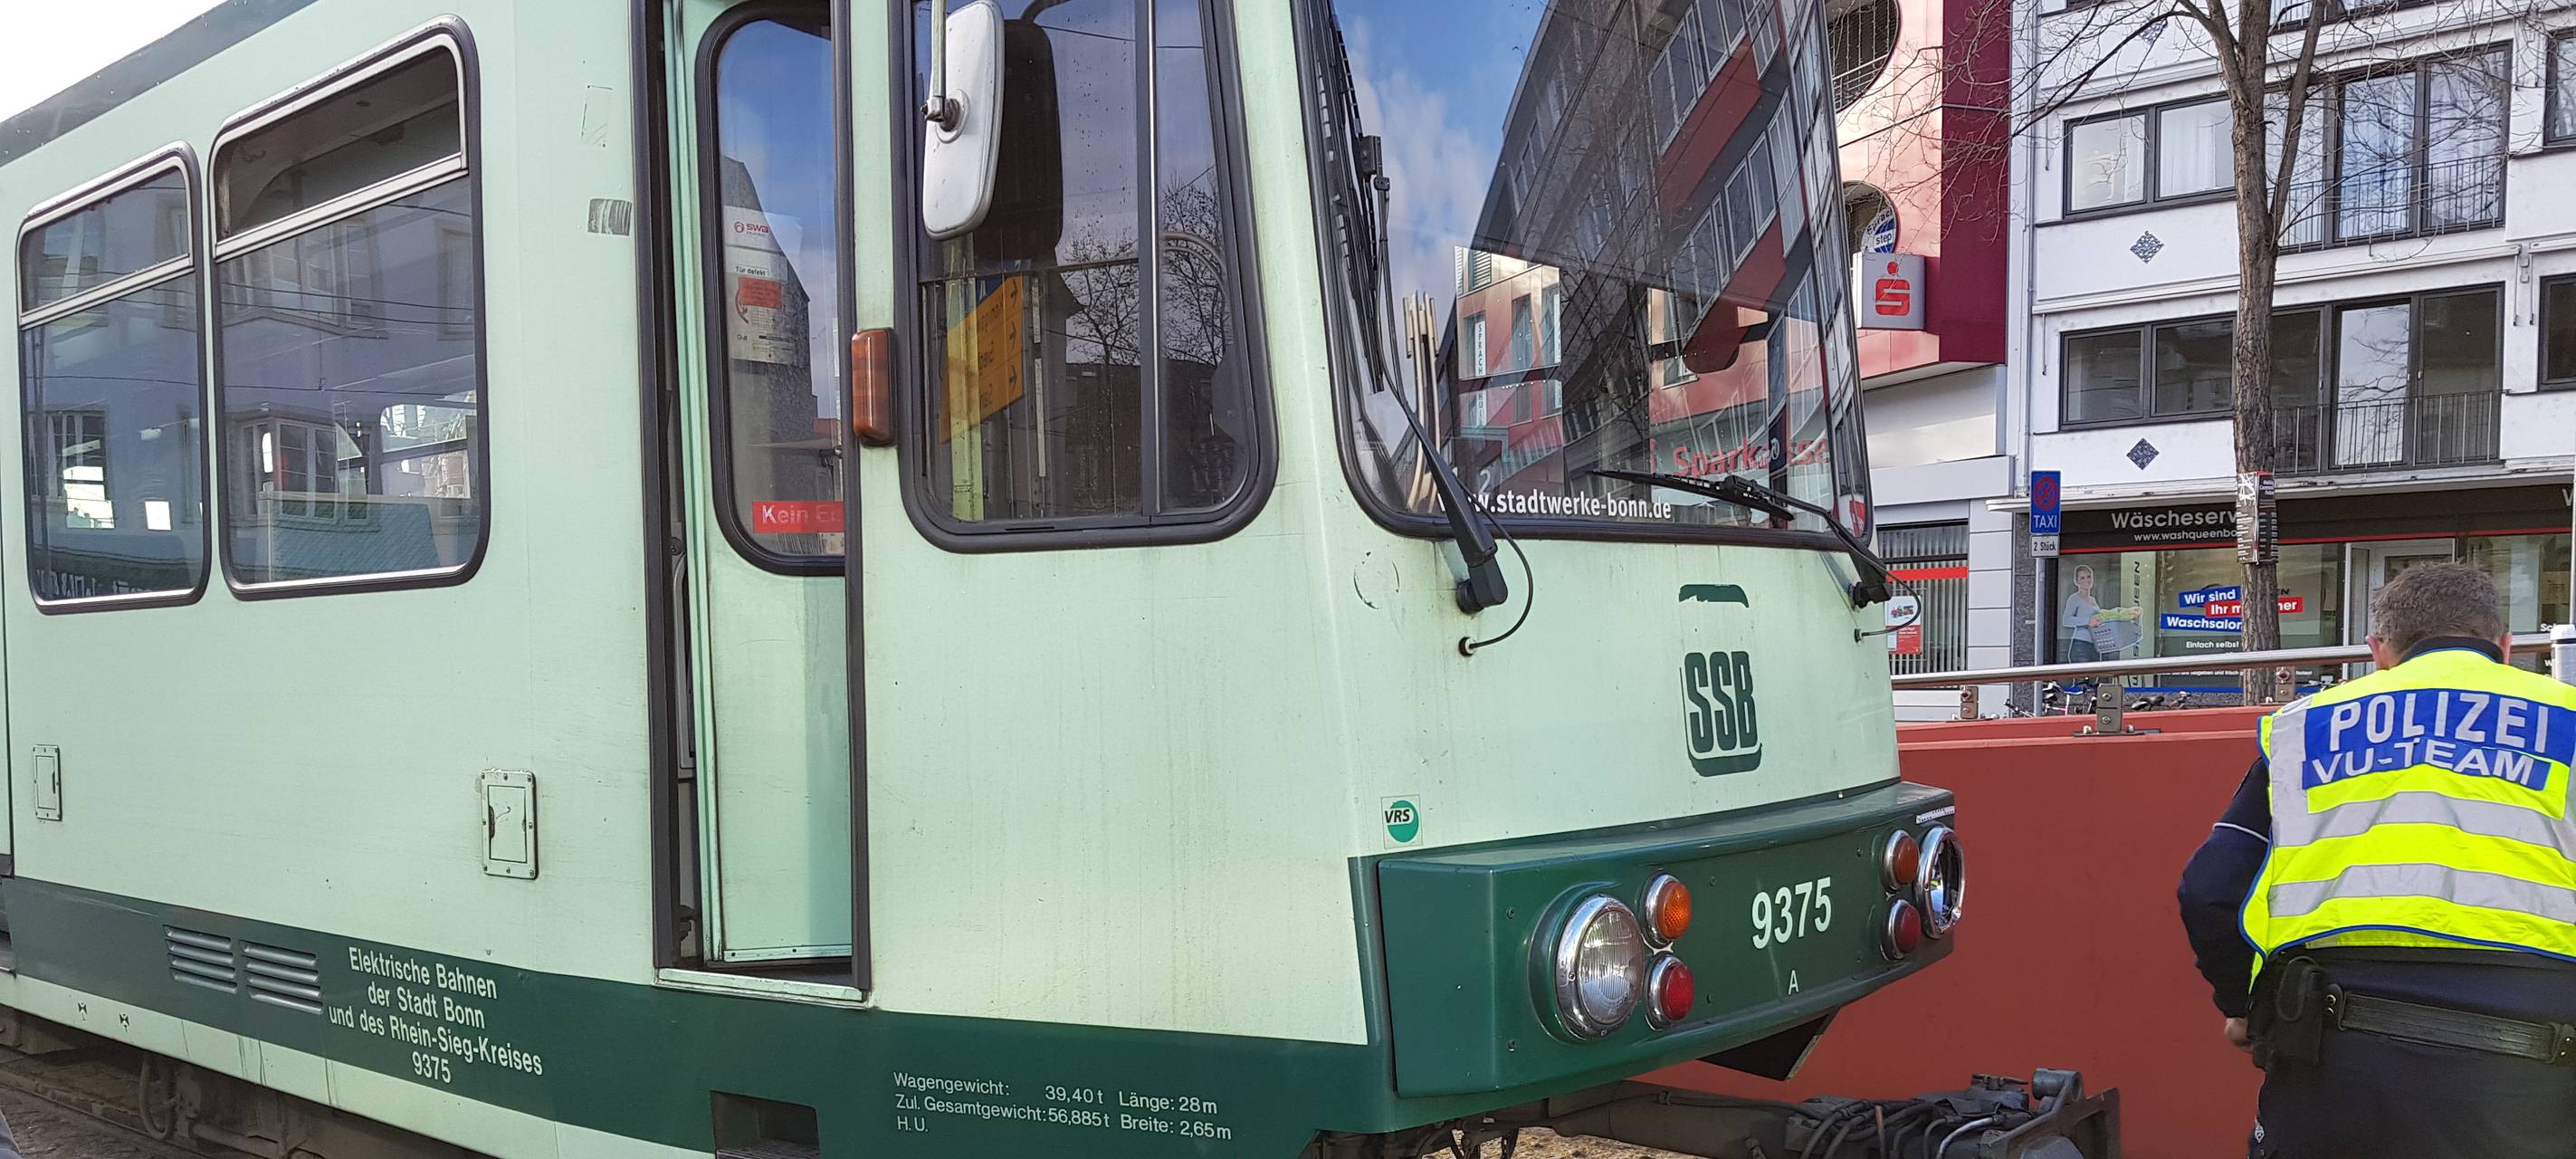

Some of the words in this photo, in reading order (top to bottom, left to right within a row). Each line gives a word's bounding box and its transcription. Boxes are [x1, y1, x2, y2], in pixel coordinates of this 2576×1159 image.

[1875, 233, 1893, 245] step
[761, 504, 808, 524] Kein
[1437, 488, 1672, 520] w.stadtwerke-bonn.de
[2033, 514, 2057, 529] TAXI
[2111, 509, 2238, 530] Wäscheserv
[2033, 541, 2038, 551] 2
[2040, 541, 2056, 551] Stück
[2133, 528, 2238, 542] www.washqueenbo
[2184, 593, 2206, 605] Wir
[2209, 589, 2236, 602] sind
[2210, 604, 2228, 616] Ihr
[2186, 641, 2214, 649] Einfach
[1684, 651, 1758, 753] SSB
[2329, 691, 2549, 753] POLIZEI
[2312, 737, 2535, 786] VU-TEAM
[1384, 809, 1410, 824] VRS
[1751, 876, 1832, 949] 9375
[348, 946, 431, 985] Elektrische
[435, 963, 498, 1000] Bahnen
[1788, 970, 1799, 995] A
[367, 981, 391, 1008] der
[396, 986, 439, 1019] Stadt
[444, 996, 485, 1030] Bonn
[329, 1005, 354, 1029] und
[359, 1010, 386, 1036] des
[389, 1015, 543, 1076] Rhein-Sieg-Kreises
[412, 1051, 452, 1084] 9375
[893, 1071, 1010, 1097] Wagengewicht:
[1119, 1090, 1175, 1112] Länge:
[894, 1094, 921, 1111] Zul.
[1121, 1114, 1174, 1135] Breite:
